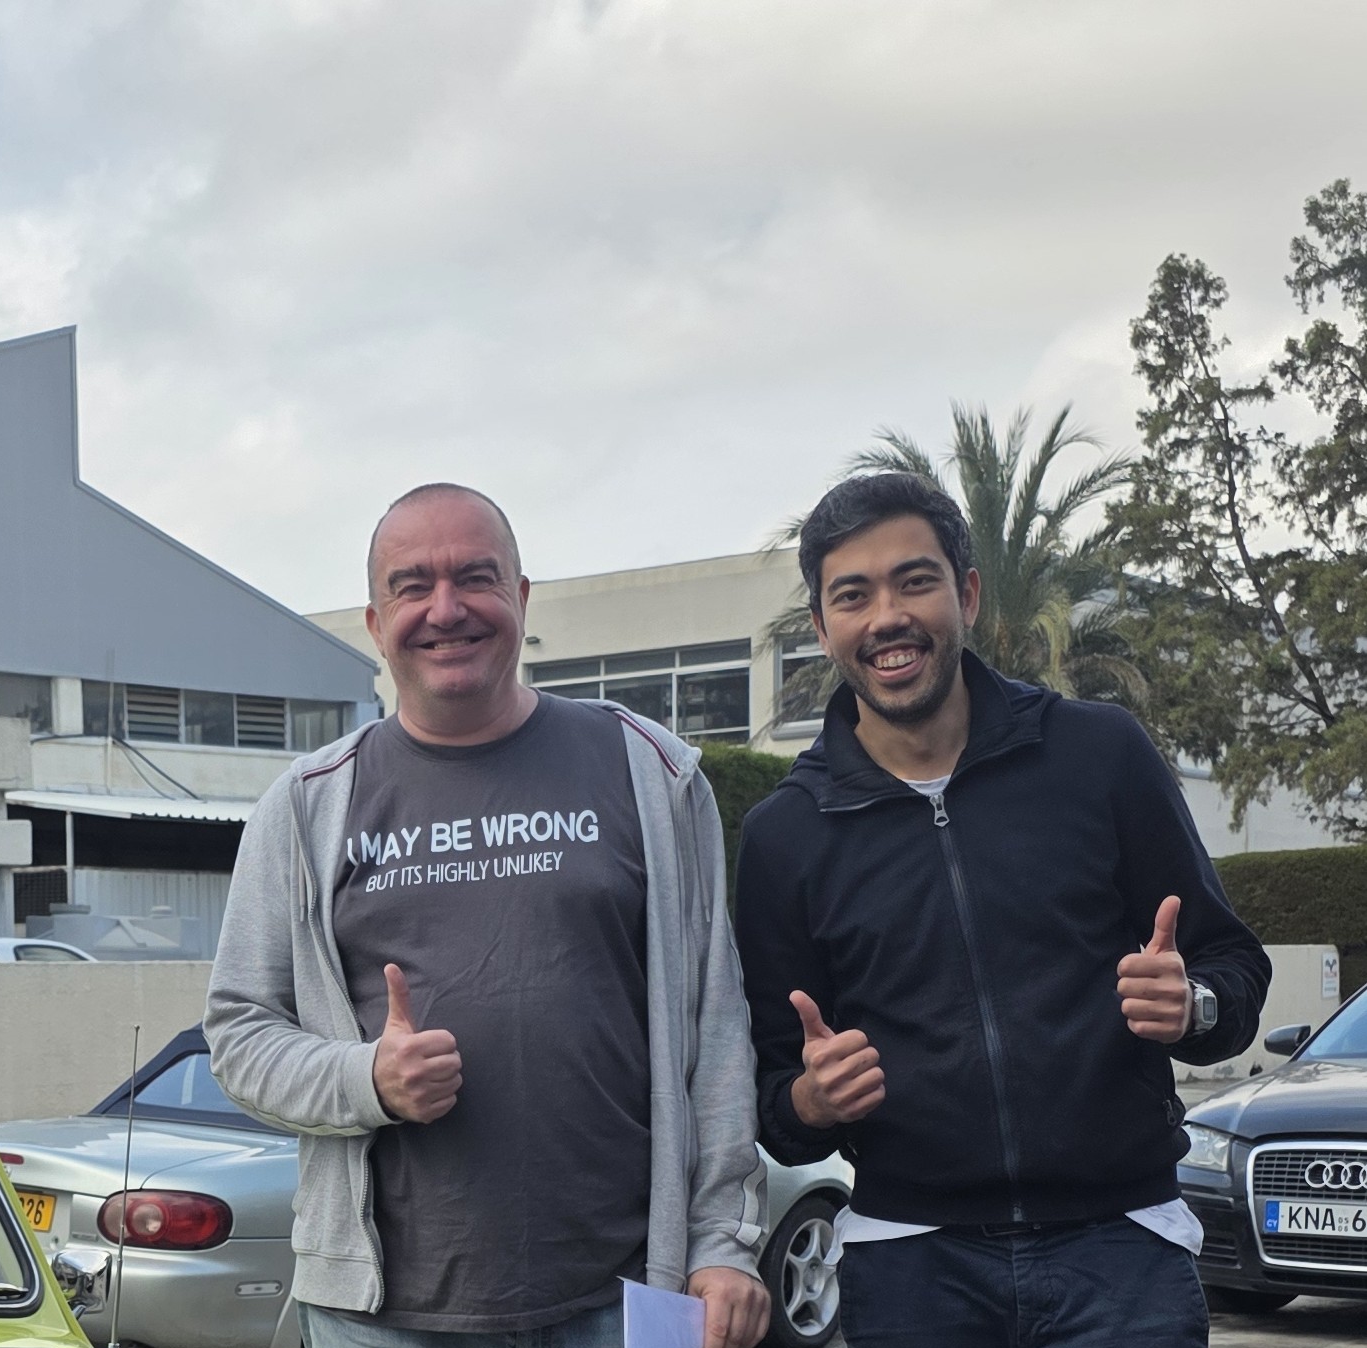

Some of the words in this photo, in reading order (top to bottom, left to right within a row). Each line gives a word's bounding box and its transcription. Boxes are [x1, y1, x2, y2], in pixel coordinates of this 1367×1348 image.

[347, 838, 359, 866] I
[361, 826, 421, 866] MAY
[430, 818, 473, 852] BE
[480, 809, 599, 848] WRONG
[365, 869, 398, 892] BUT
[400, 865, 422, 886] ITS
[427, 859, 490, 883] HIGHLY
[493, 851, 564, 878] UNLIKEY
[19, 1197, 45, 1225] 26
[1266, 1219, 1277, 1227] CY
[1288, 1206, 1336, 1231] KNA
[1352, 1209, 1366, 1232] 6
